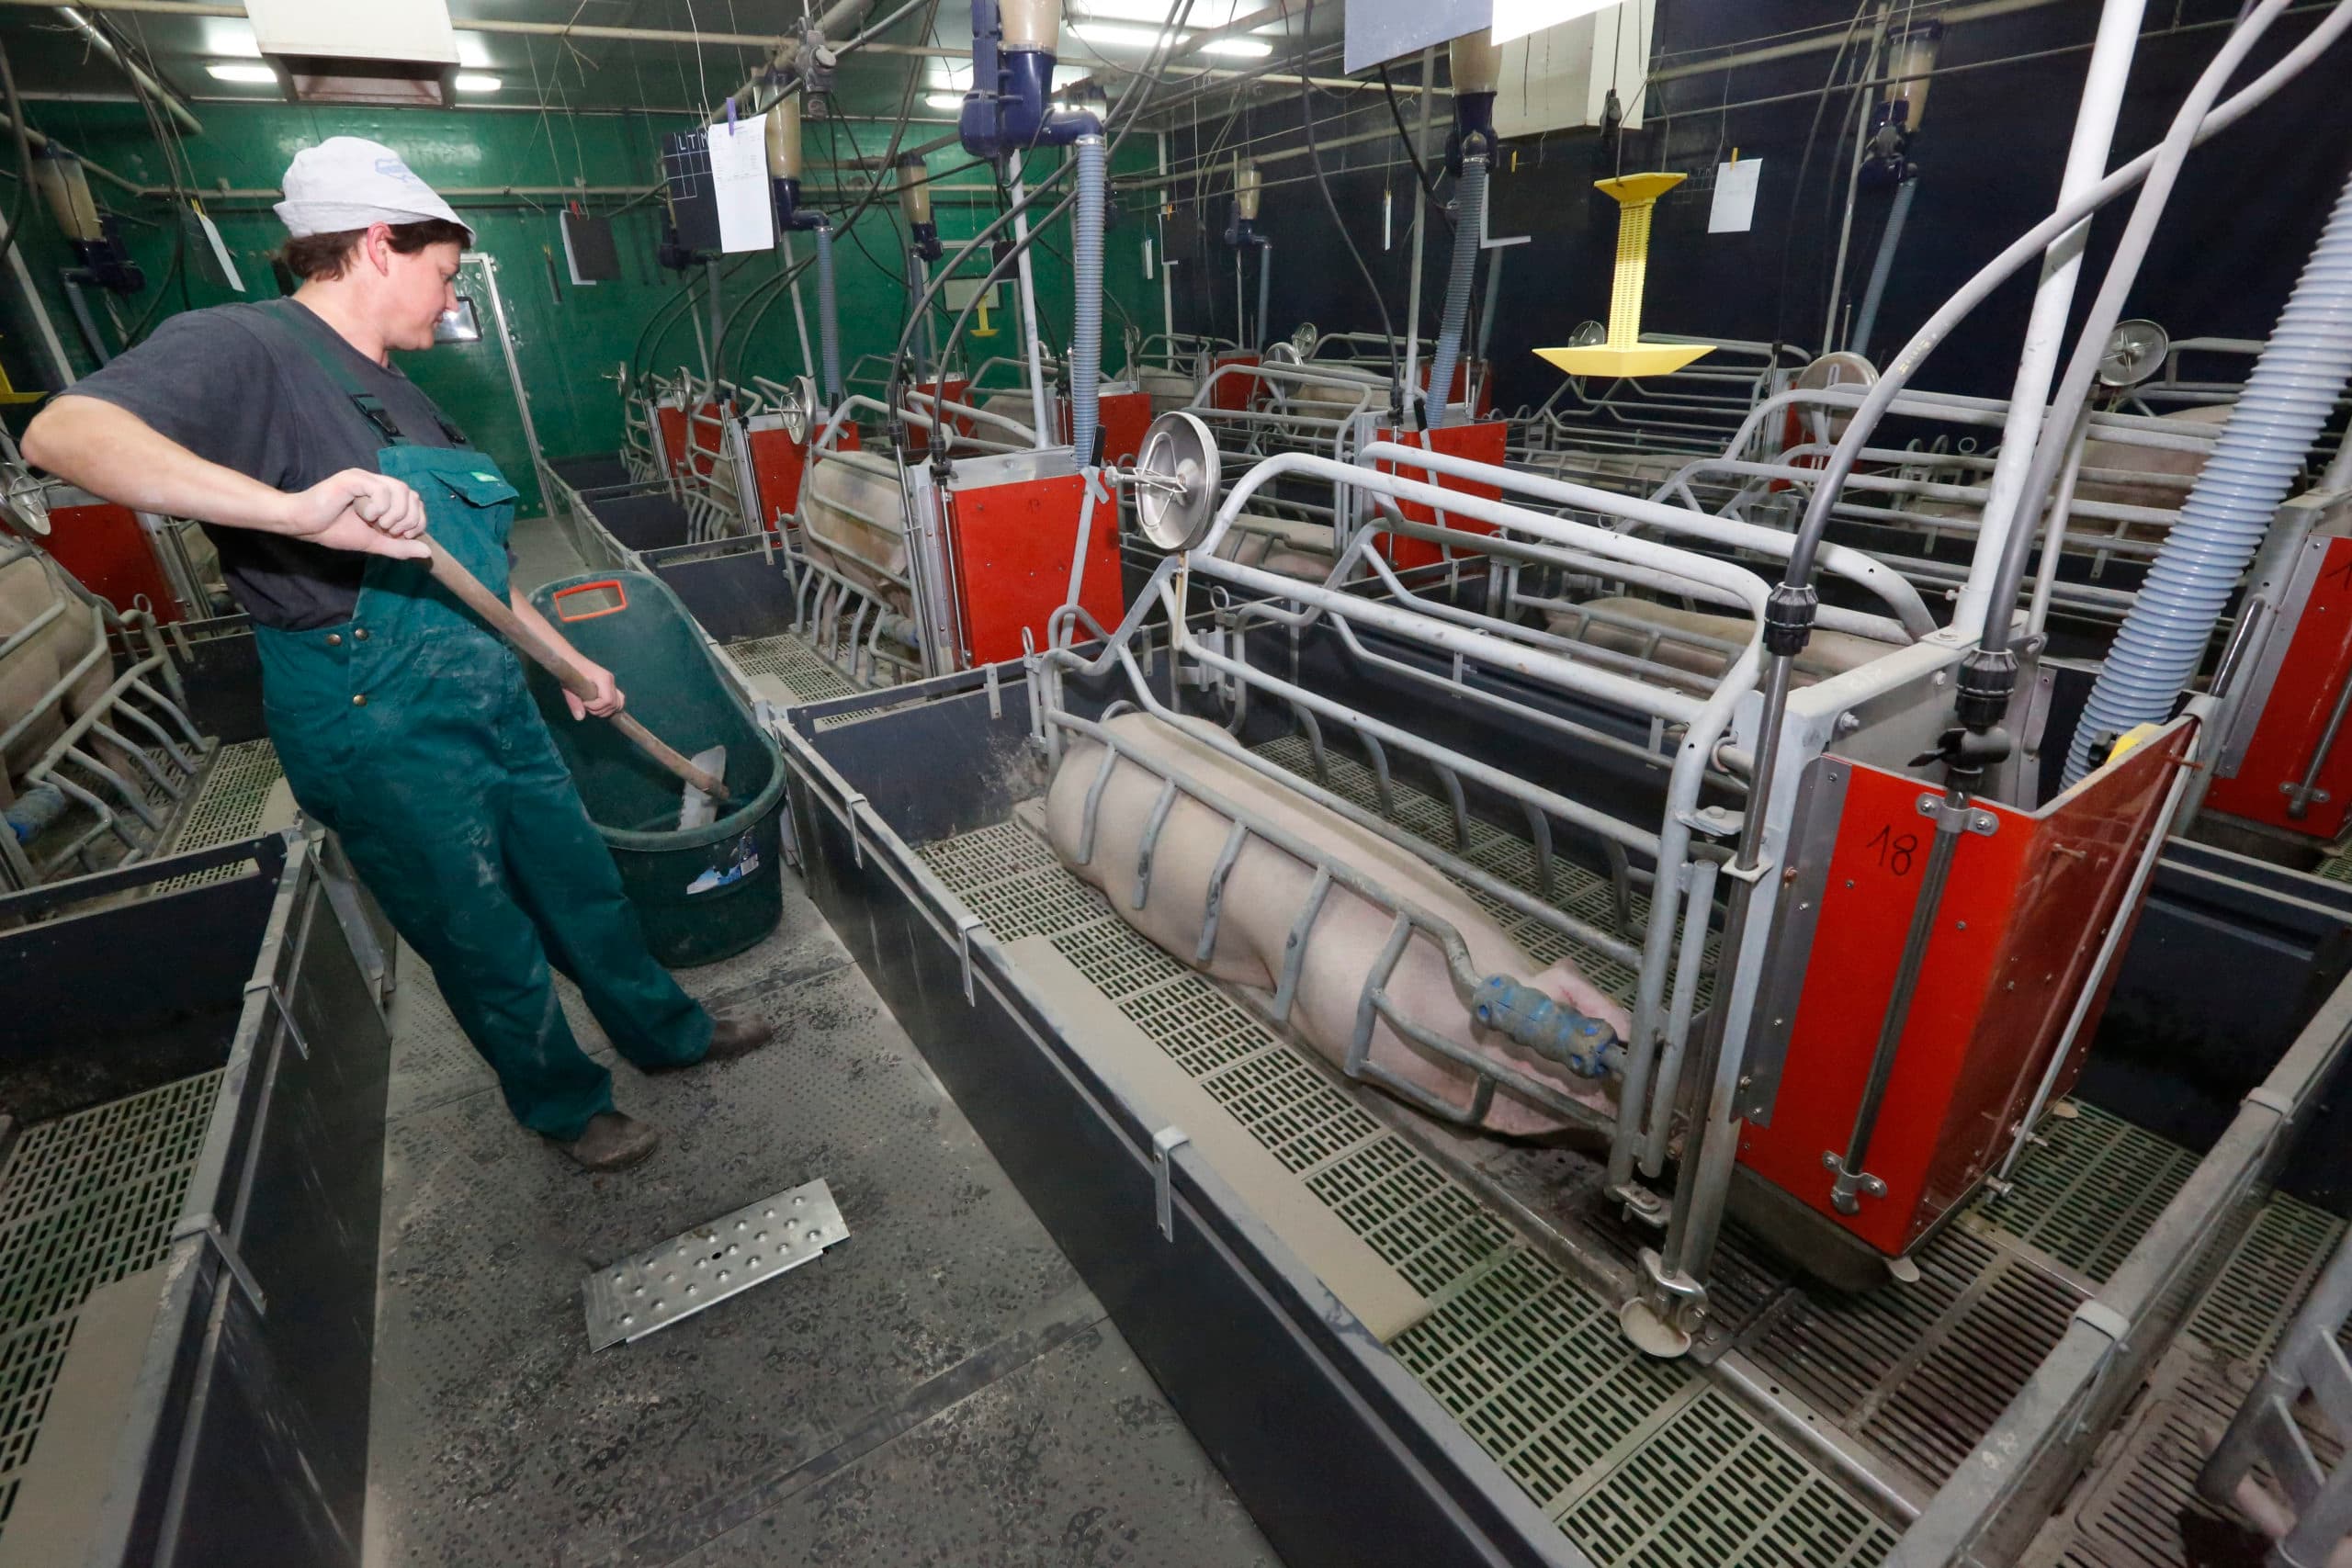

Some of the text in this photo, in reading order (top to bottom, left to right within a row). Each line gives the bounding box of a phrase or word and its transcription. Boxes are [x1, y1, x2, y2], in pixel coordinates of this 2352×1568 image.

[678, 134, 686, 151] L
[687, 133, 696, 150] T
[1866, 824, 1918, 876] 18
